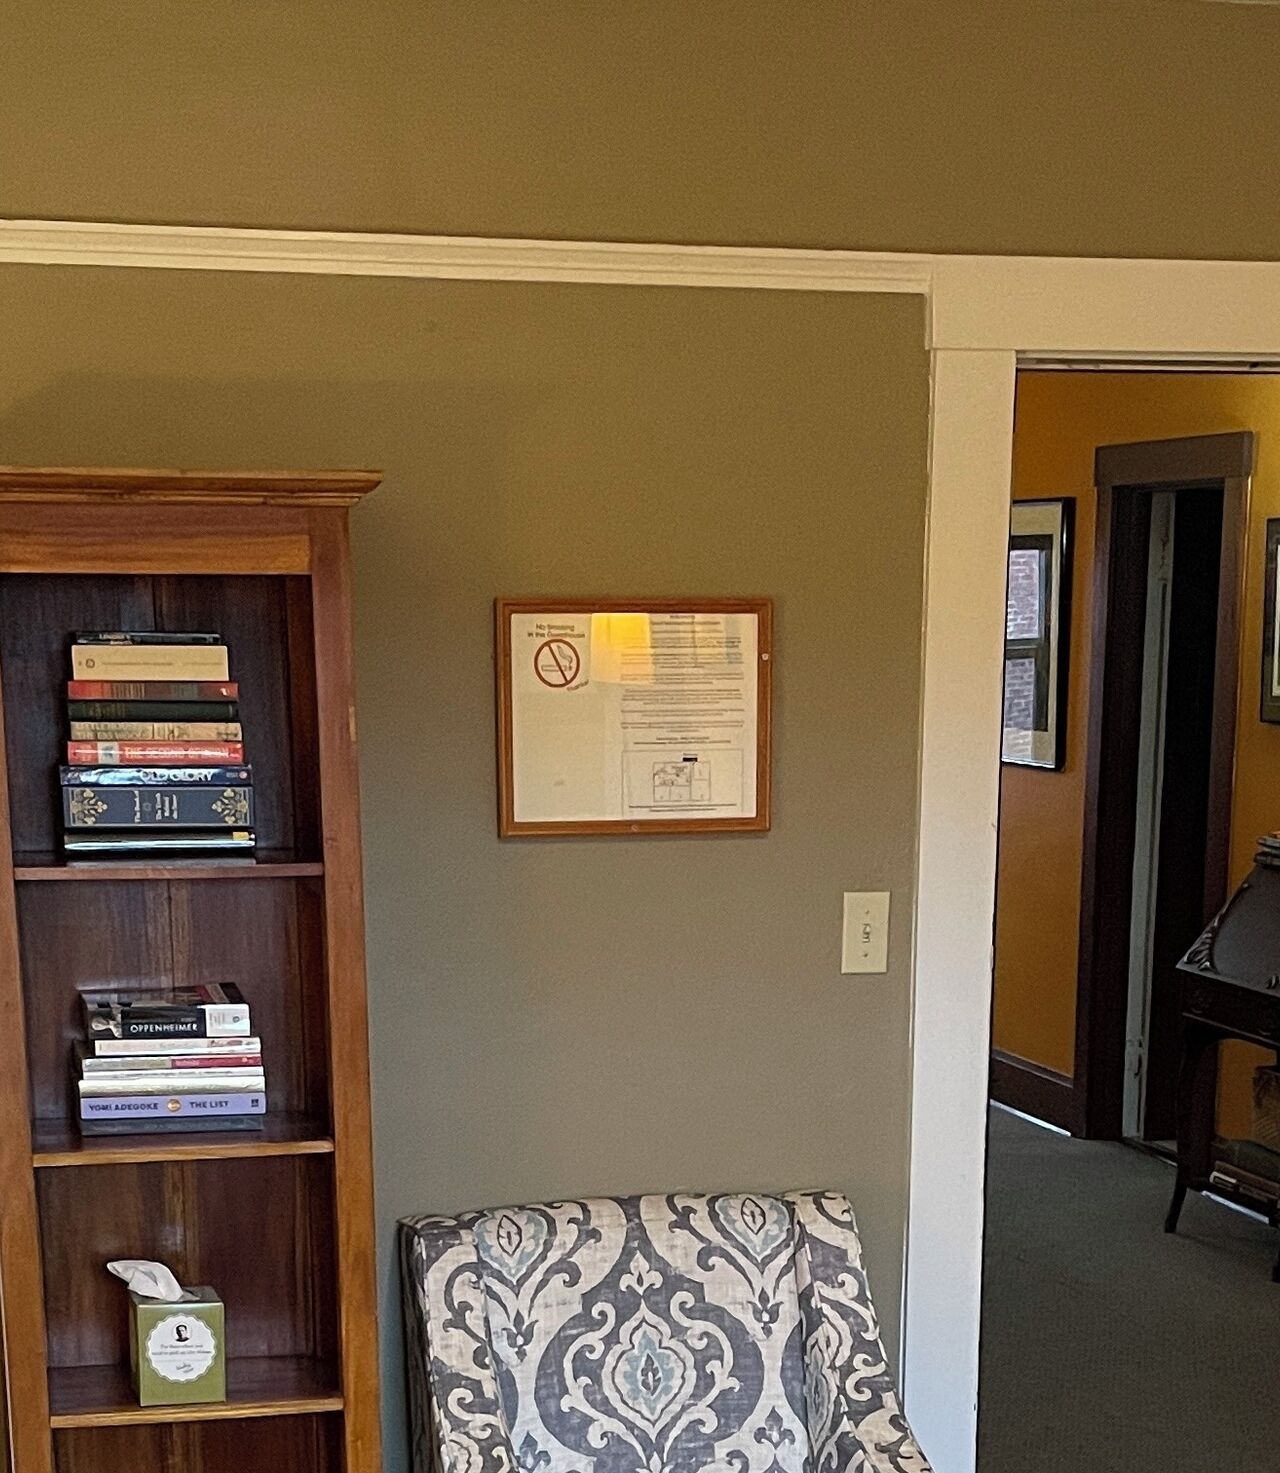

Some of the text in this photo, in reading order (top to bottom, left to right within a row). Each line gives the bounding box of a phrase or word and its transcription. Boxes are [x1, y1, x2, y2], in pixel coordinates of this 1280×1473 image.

[139, 769, 214, 782] OLD GLORY
[130, 1023, 198, 1034] OPPENHEIMER
[89, 1100, 229, 1112] YOMI ADEGOKE THE LIST
